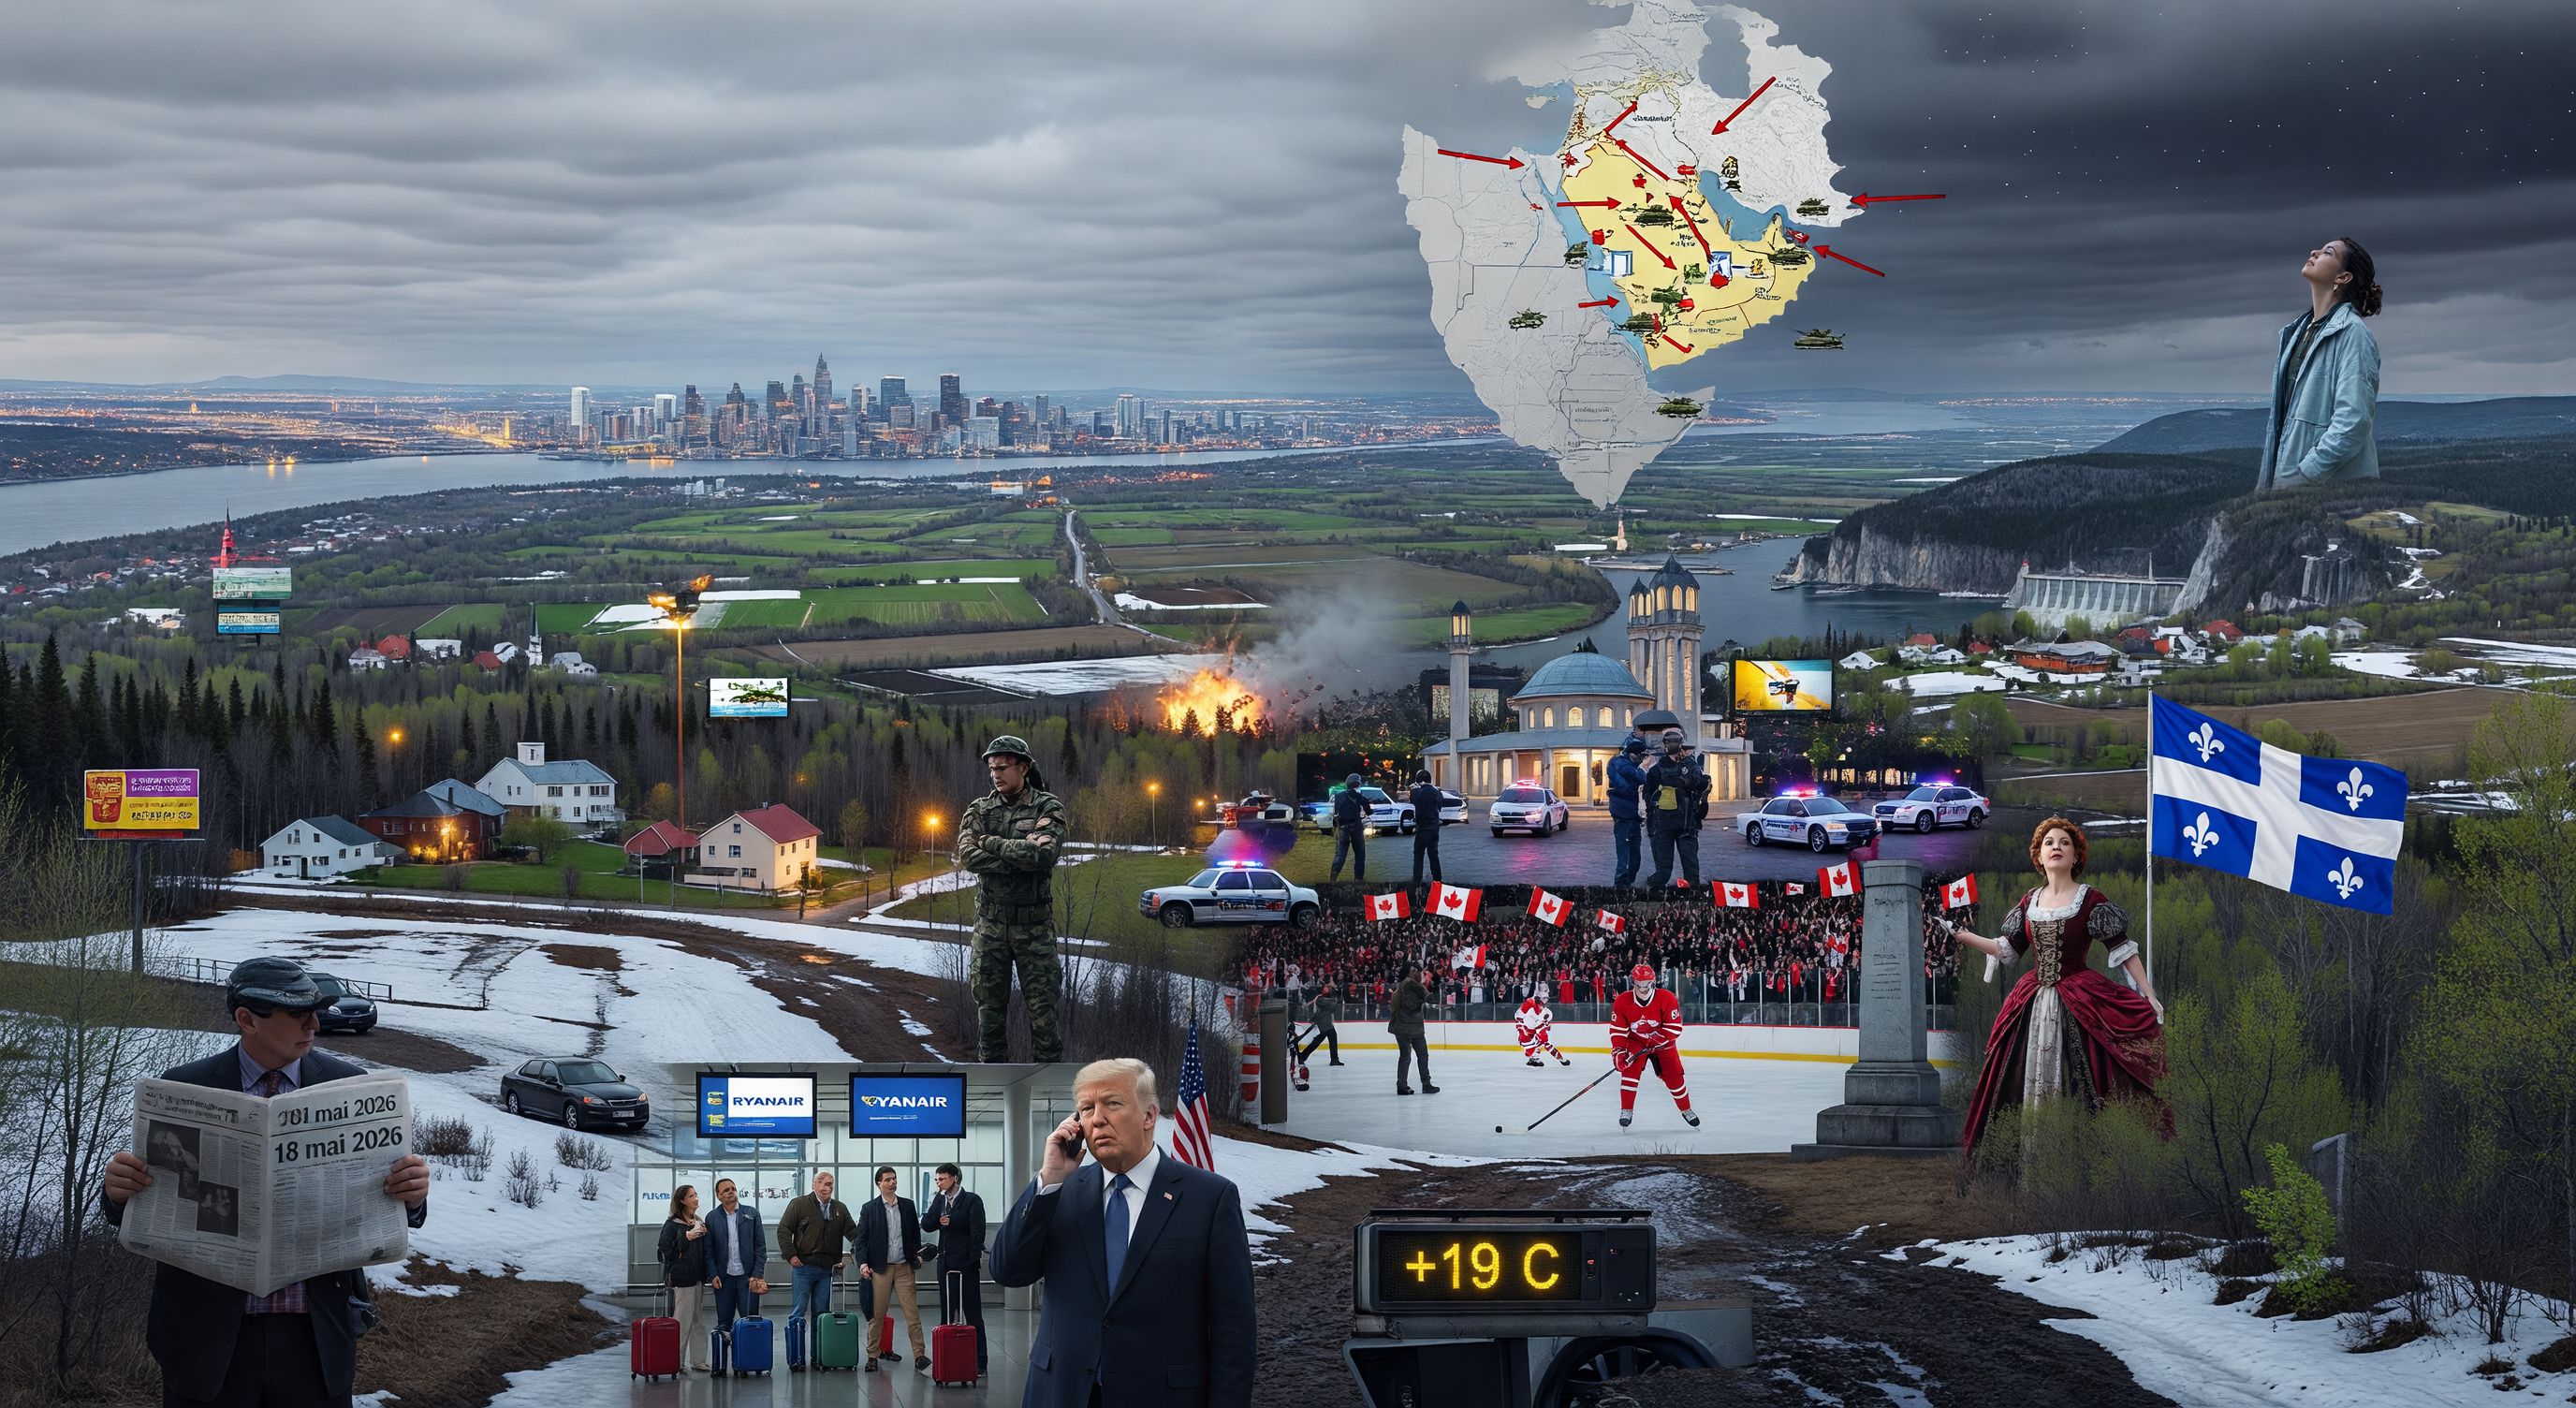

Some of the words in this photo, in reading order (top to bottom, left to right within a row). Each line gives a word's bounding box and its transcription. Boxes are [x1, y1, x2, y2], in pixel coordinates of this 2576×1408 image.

[315, 1101, 349, 1122] mai
[354, 1094, 396, 1117] 2026
[733, 1096, 804, 1106] RYANAIR
[274, 1141, 299, 1164] 18
[305, 1133, 345, 1159] mai
[352, 1125, 402, 1152] 2026
[1406, 1242, 1500, 1289] +19
[1524, 1242, 1559, 1289] C
